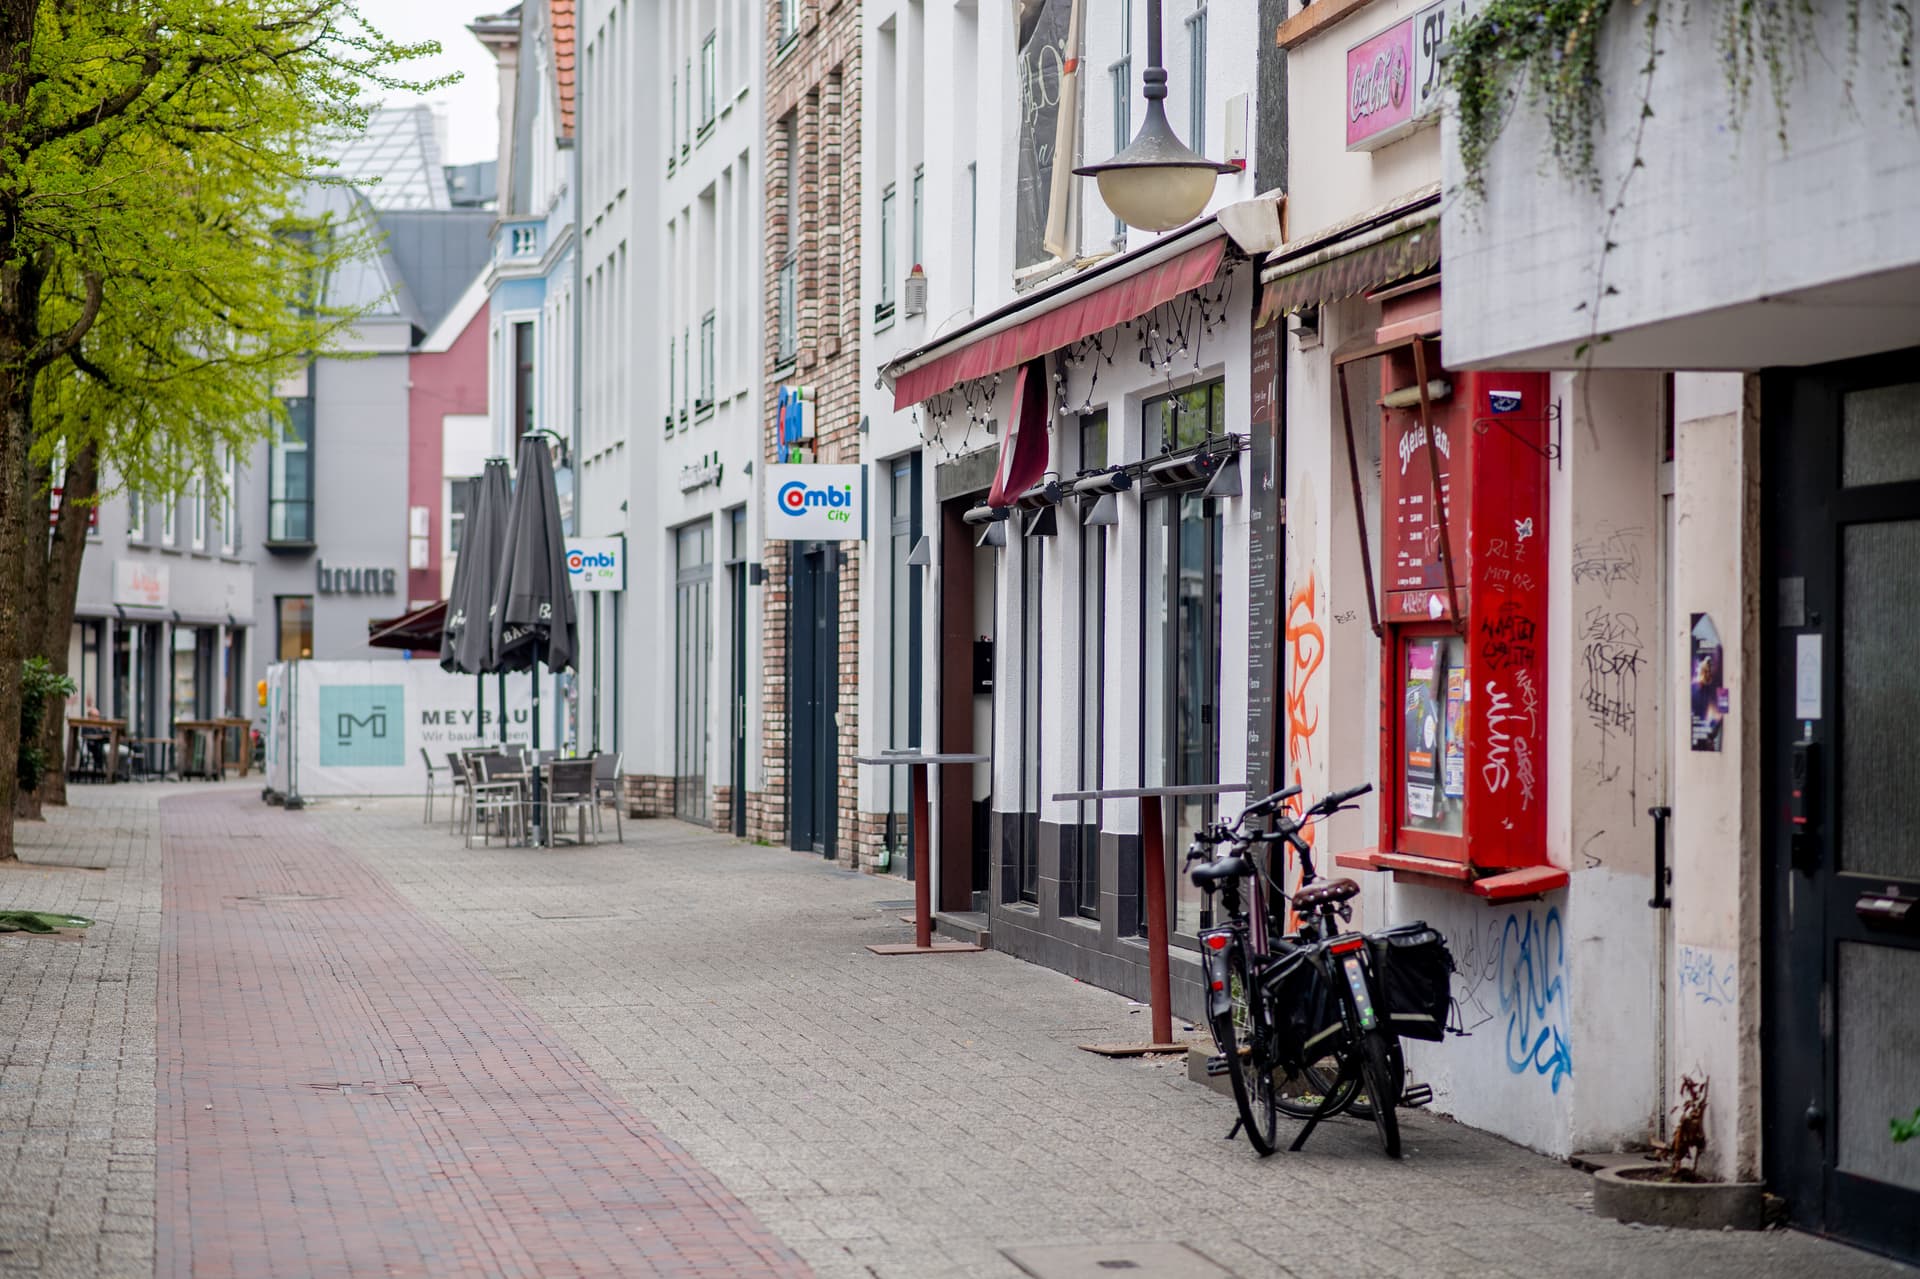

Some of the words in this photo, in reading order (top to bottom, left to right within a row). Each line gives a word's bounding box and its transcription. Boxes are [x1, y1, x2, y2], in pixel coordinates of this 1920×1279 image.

[778, 481, 851, 516] Combi
[827, 509, 850, 523] City
[317, 559, 396, 594] bruns
[565, 549, 615, 574] Combi
